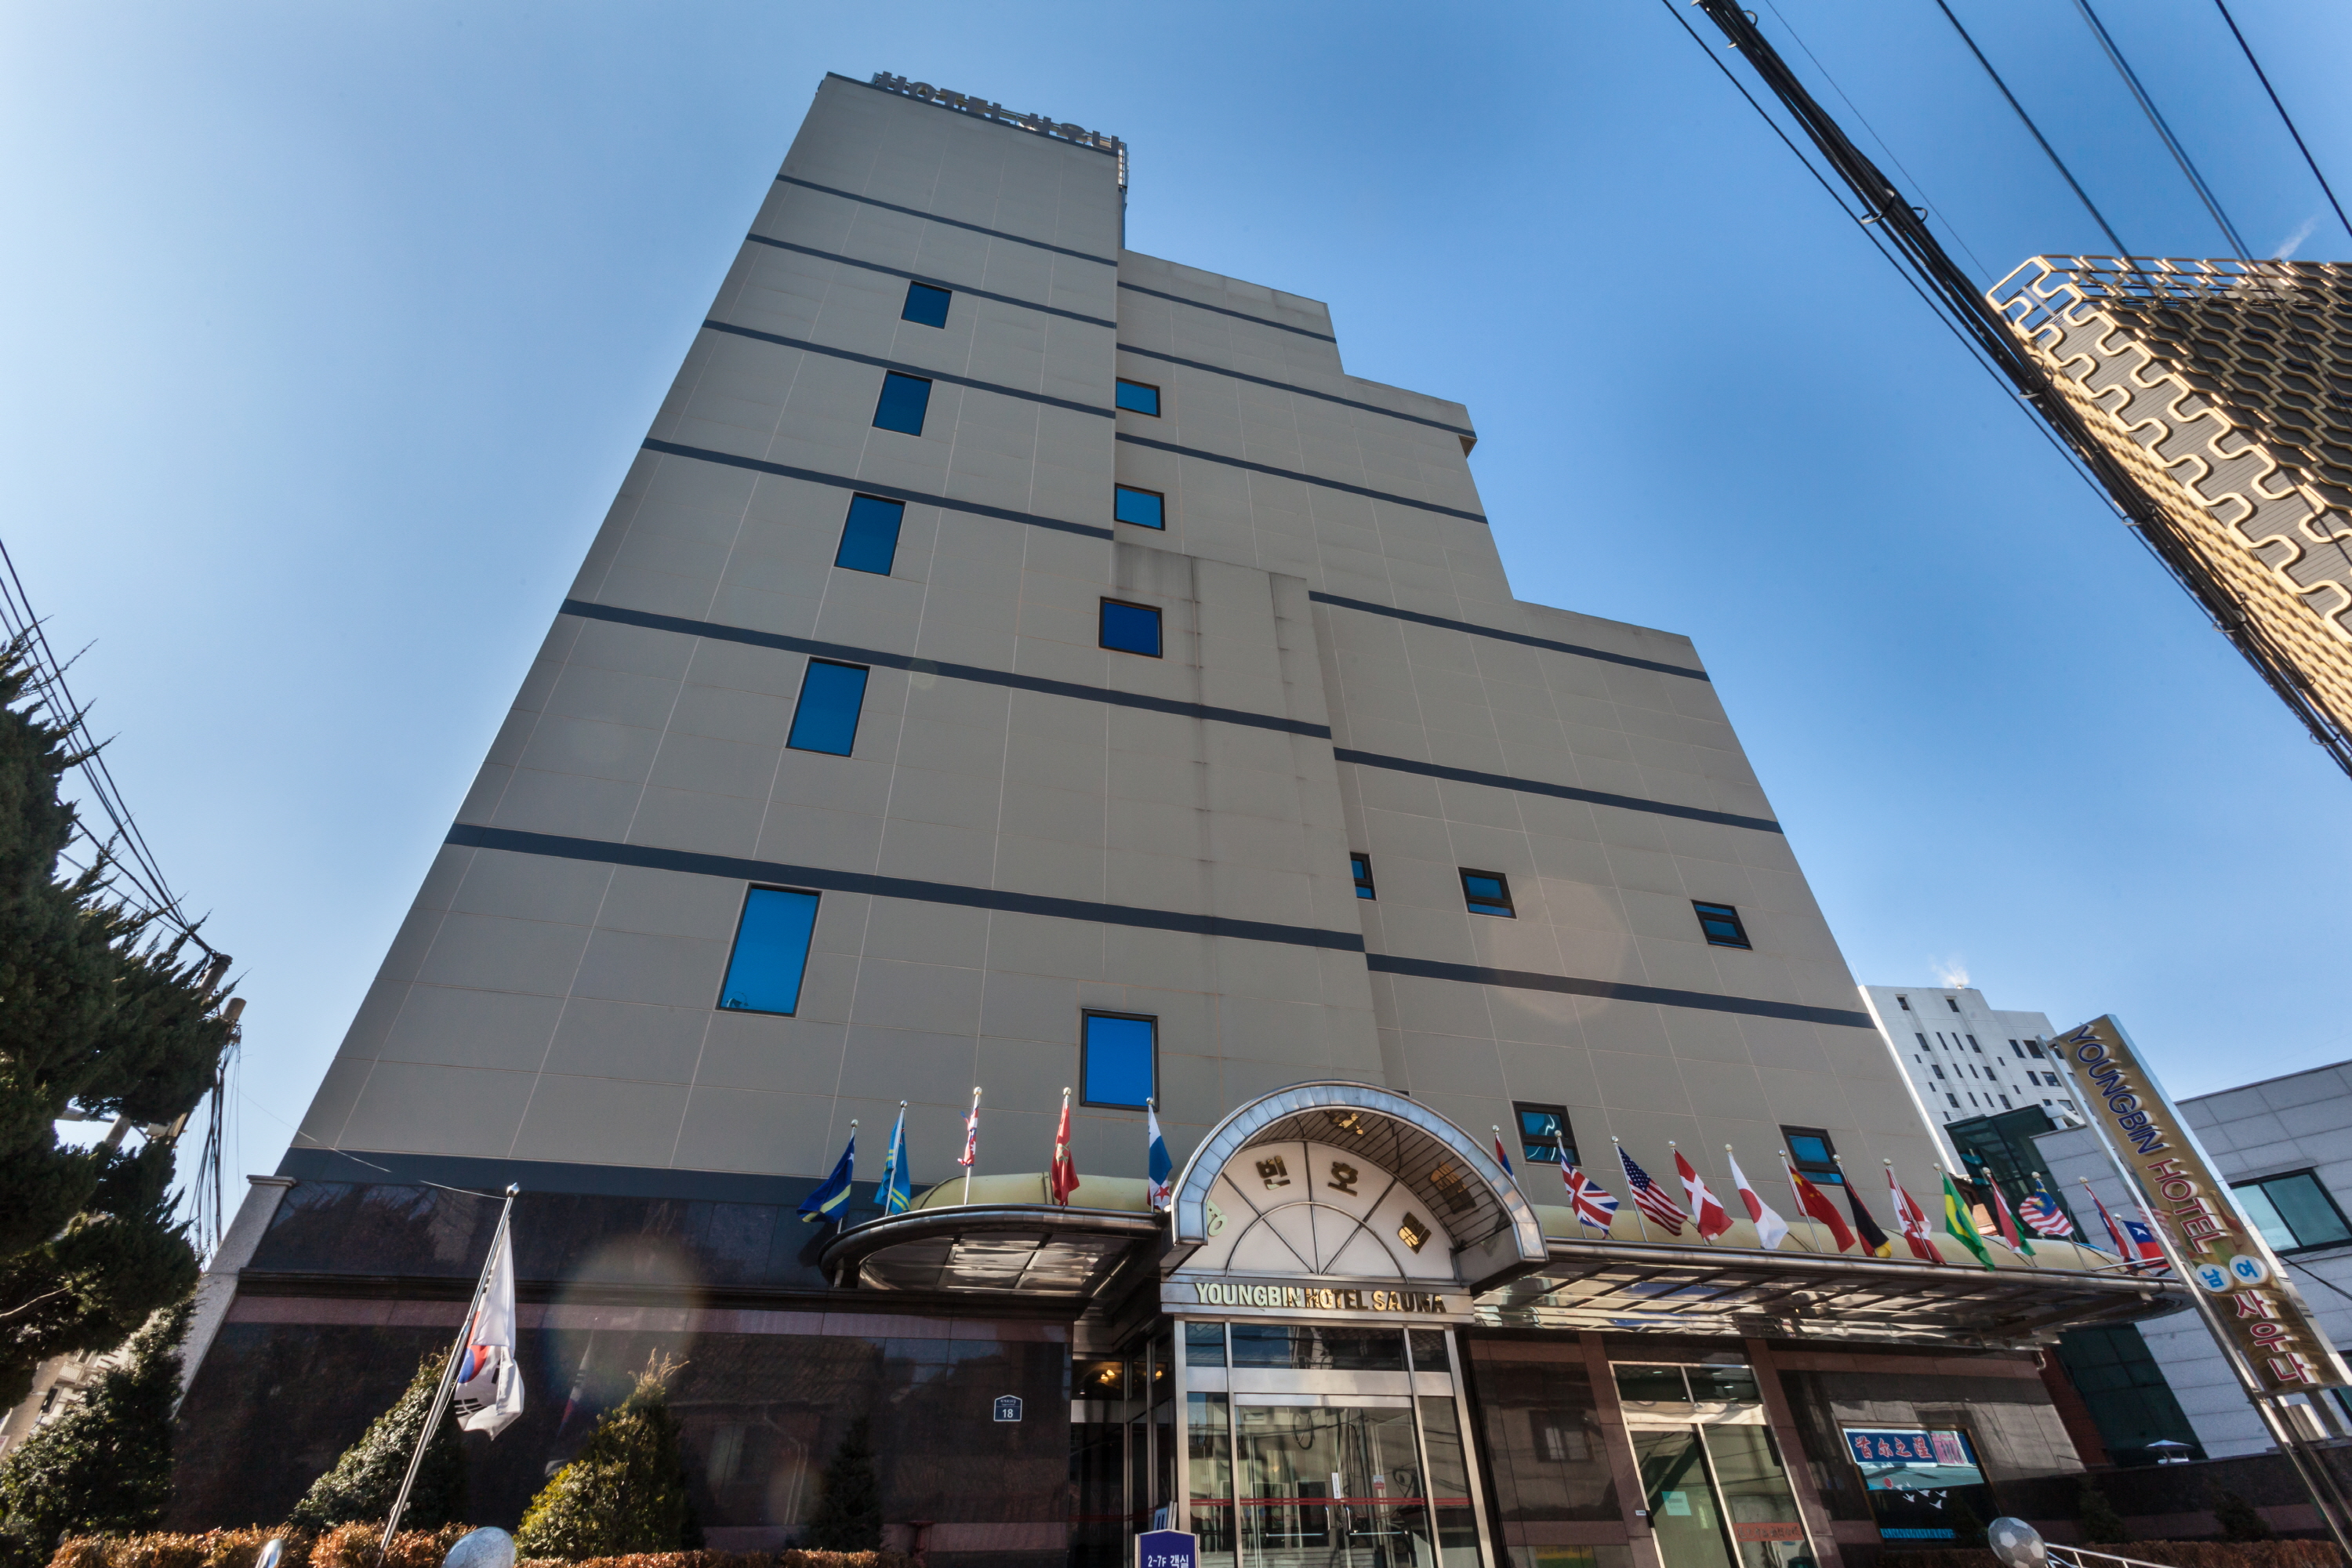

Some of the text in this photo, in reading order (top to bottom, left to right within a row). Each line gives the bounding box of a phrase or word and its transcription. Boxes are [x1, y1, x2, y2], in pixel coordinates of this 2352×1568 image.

[877, 71, 1010, 125] HOTEL
[2068, 1024, 2223, 1254] YOUNGBIN HOTEL
[2201, 1260, 2259, 1288] 남 여
[1195, 1283, 1447, 1313] YOUNGBIN HOTEL SAUNA
[2233, 1289, 2314, 1385] 사우나
[1002, 1408, 1014, 1418] 18
[1854, 1435, 1933, 1459] 首尔之星
